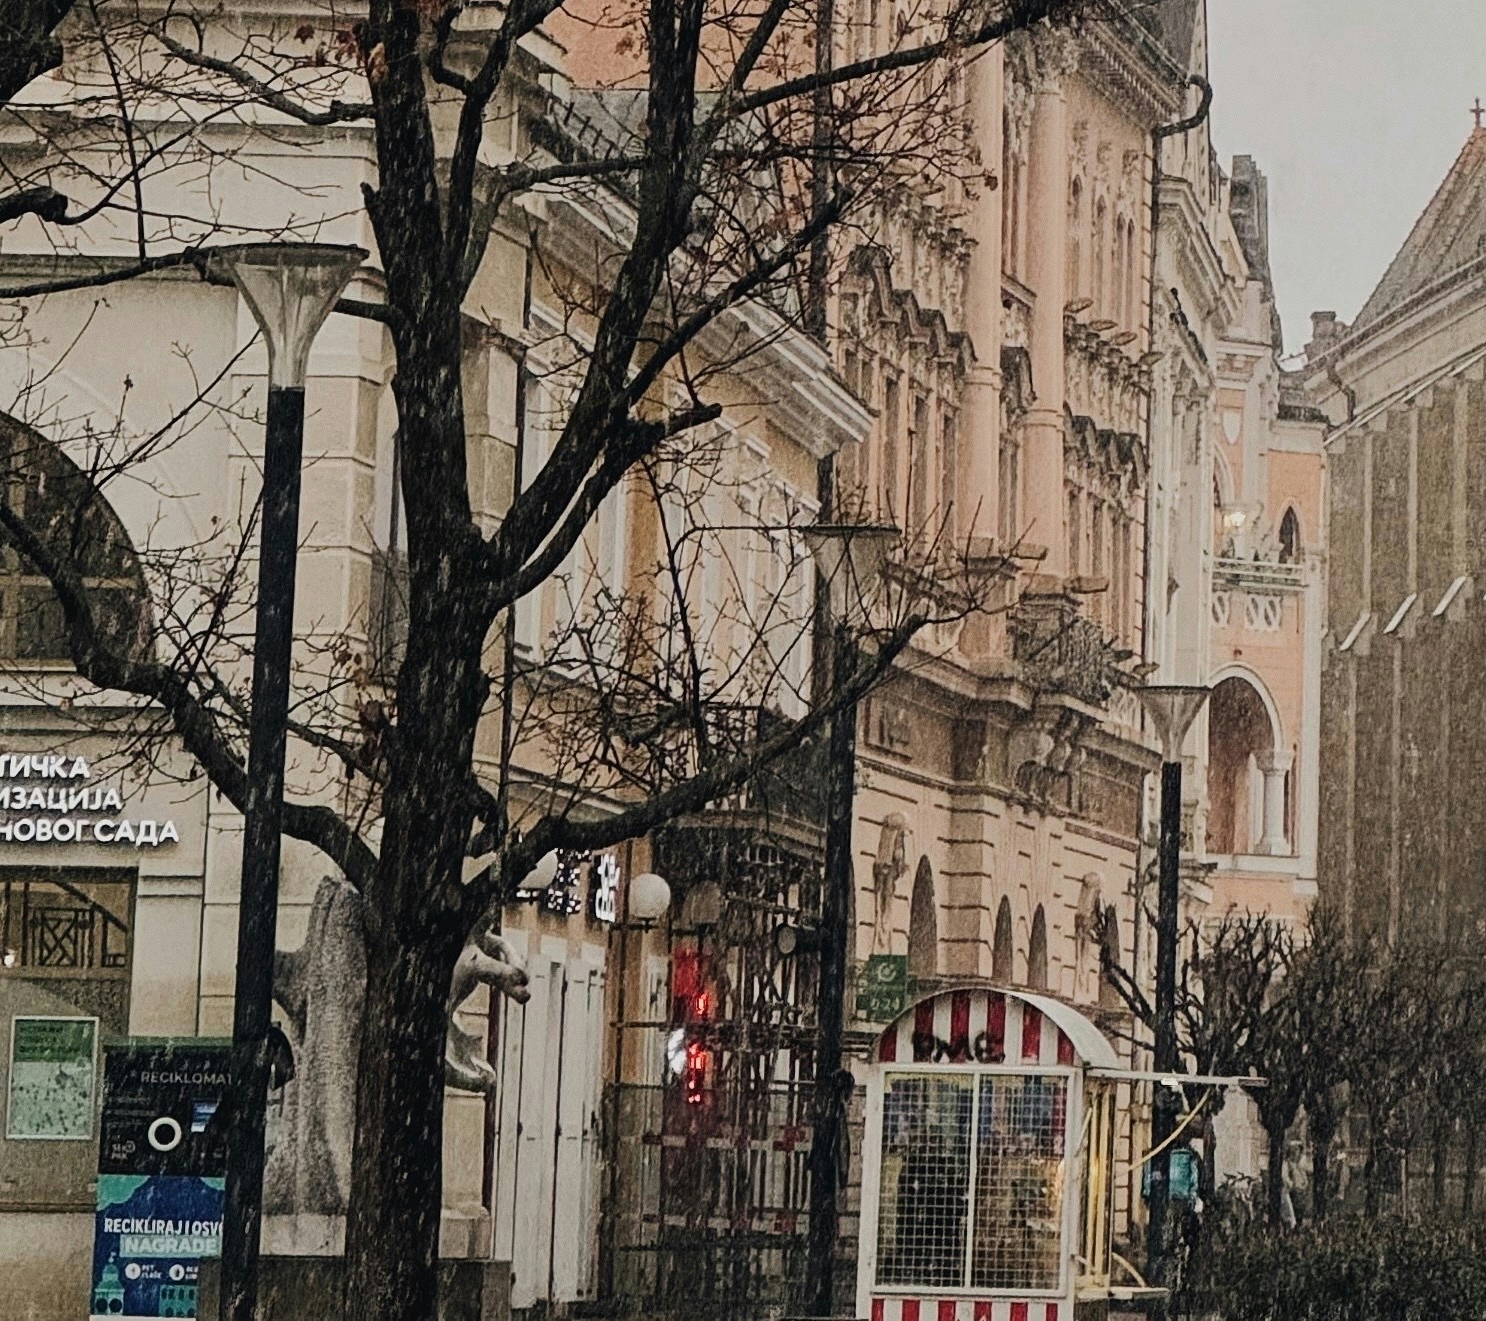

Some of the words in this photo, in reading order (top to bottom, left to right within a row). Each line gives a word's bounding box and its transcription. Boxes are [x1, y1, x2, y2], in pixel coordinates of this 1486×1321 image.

[0, 818, 90, 842] НОВОГ
[94, 819, 179, 846] САДА
[104, 1218, 182, 1235] RECIKLIRAJ
[125, 1238, 217, 1254] NAGRADE
